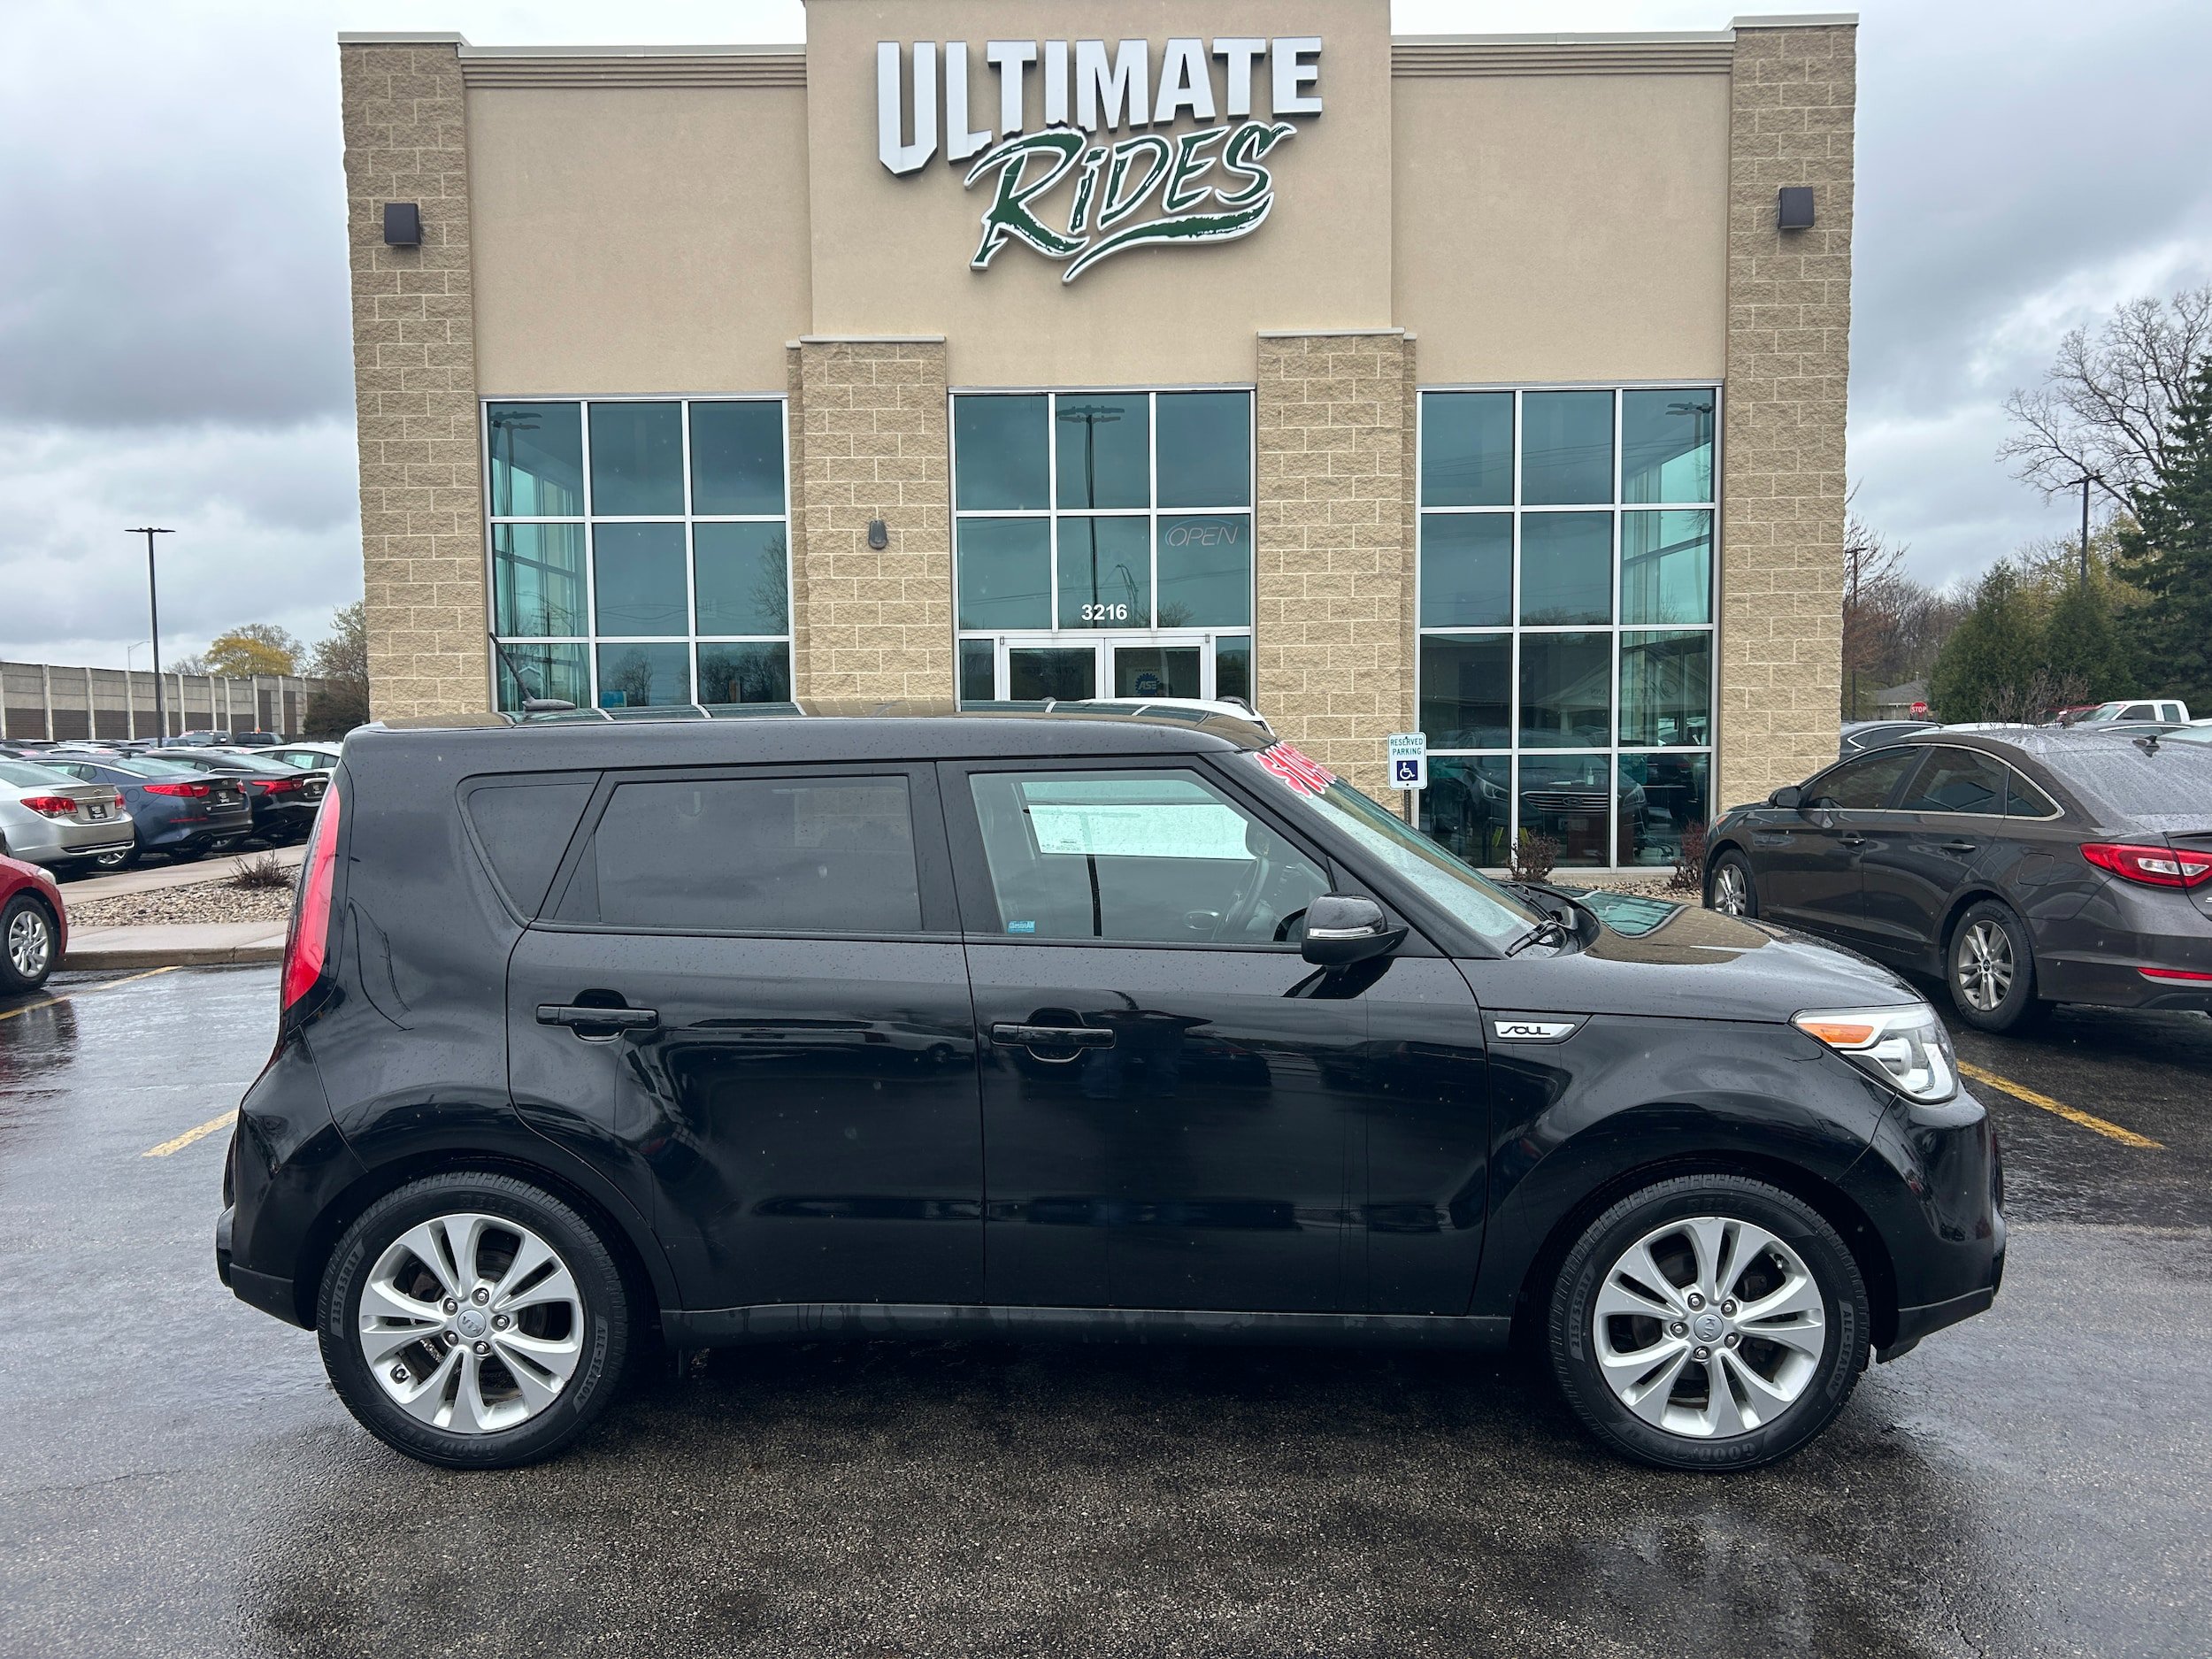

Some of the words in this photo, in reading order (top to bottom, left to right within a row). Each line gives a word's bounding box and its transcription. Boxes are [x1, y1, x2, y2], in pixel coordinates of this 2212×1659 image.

[877, 36, 1324, 177] ULTIMATE
[1168, 526, 1239, 547] OPEN
[1081, 603, 1128, 621] 3216
[1138, 680, 1157, 690] ASE
[1390, 738, 1424, 747] RESERVED
[332, 1251, 360, 1325] 215/55R17
[576, 1325, 607, 1403] ALL-SEASON
[1828, 1310, 1853, 1392] ALL-SEASON
